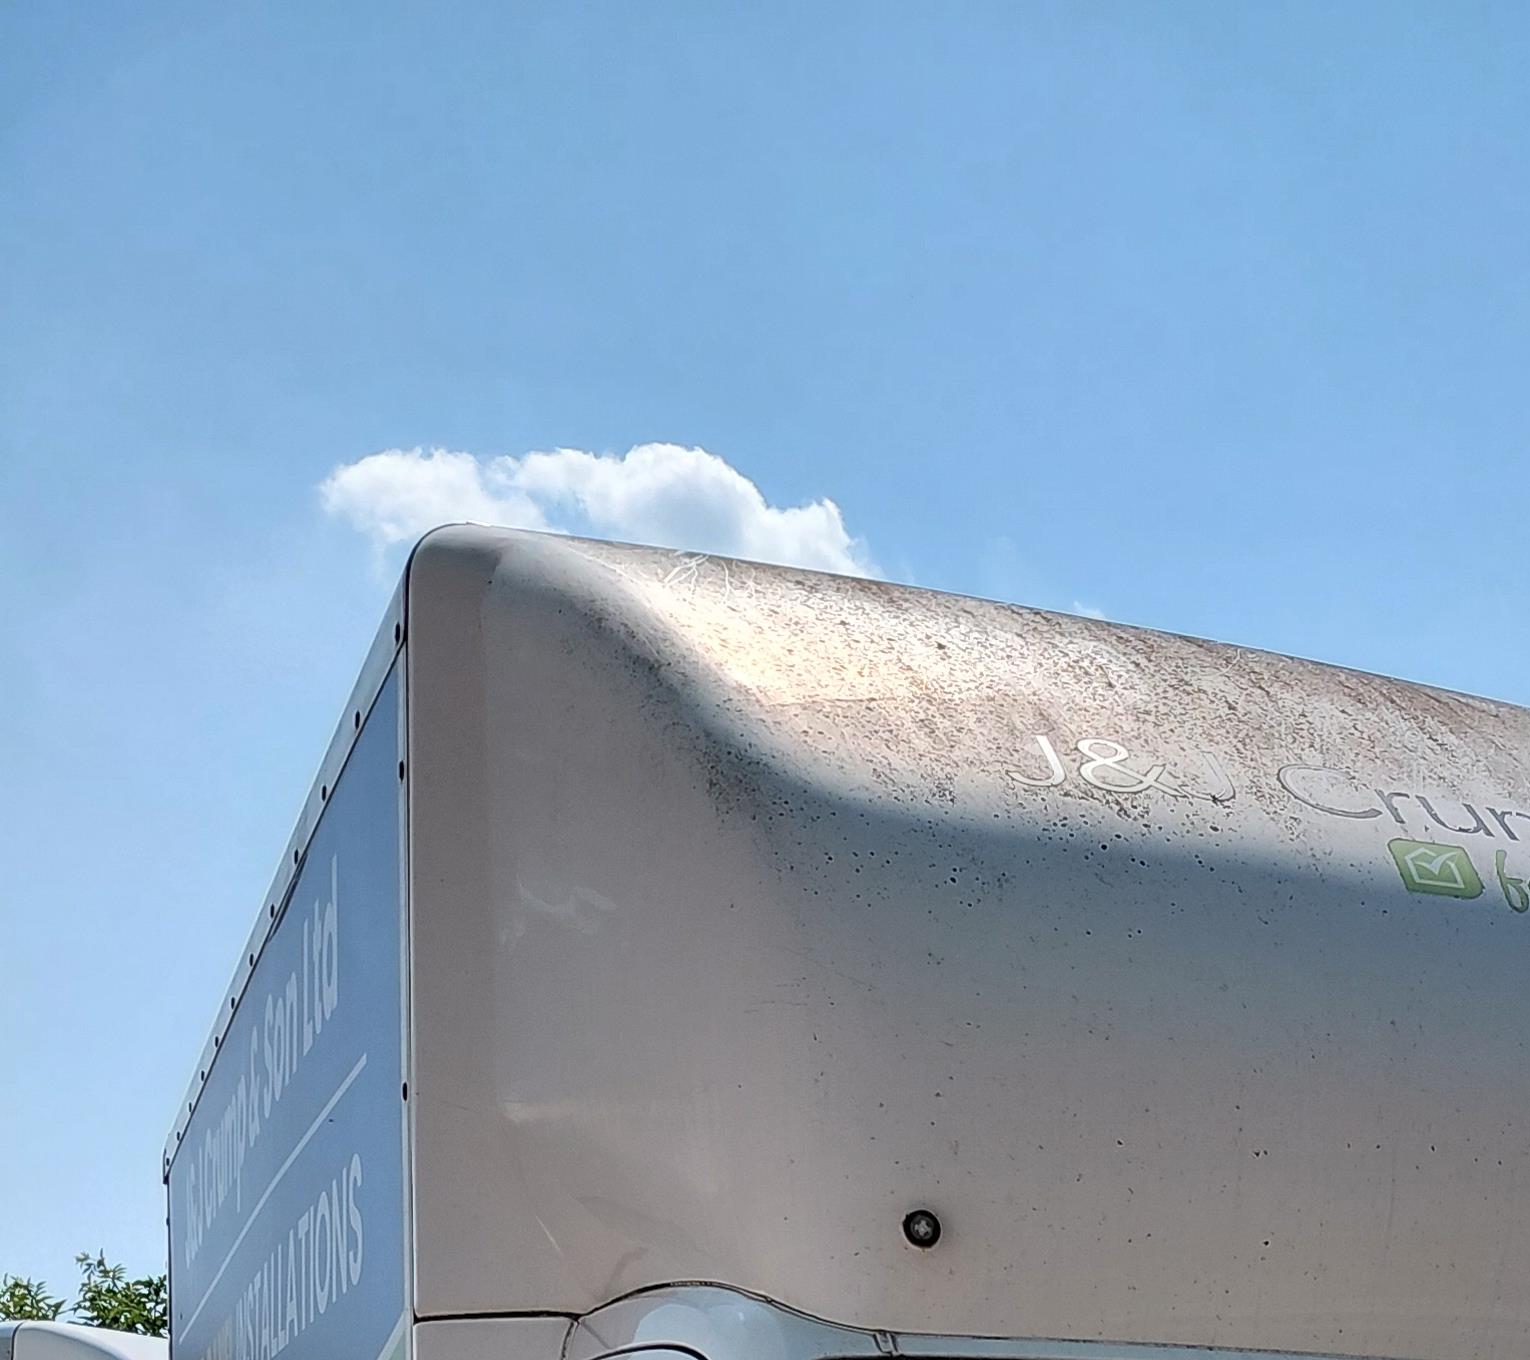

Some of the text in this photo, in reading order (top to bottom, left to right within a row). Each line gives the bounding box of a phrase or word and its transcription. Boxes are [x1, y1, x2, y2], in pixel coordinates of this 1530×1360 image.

[249, 1025, 261, 1148] &
[263, 972, 298, 1120] Son
[302, 852, 339, 1058] Ltd
